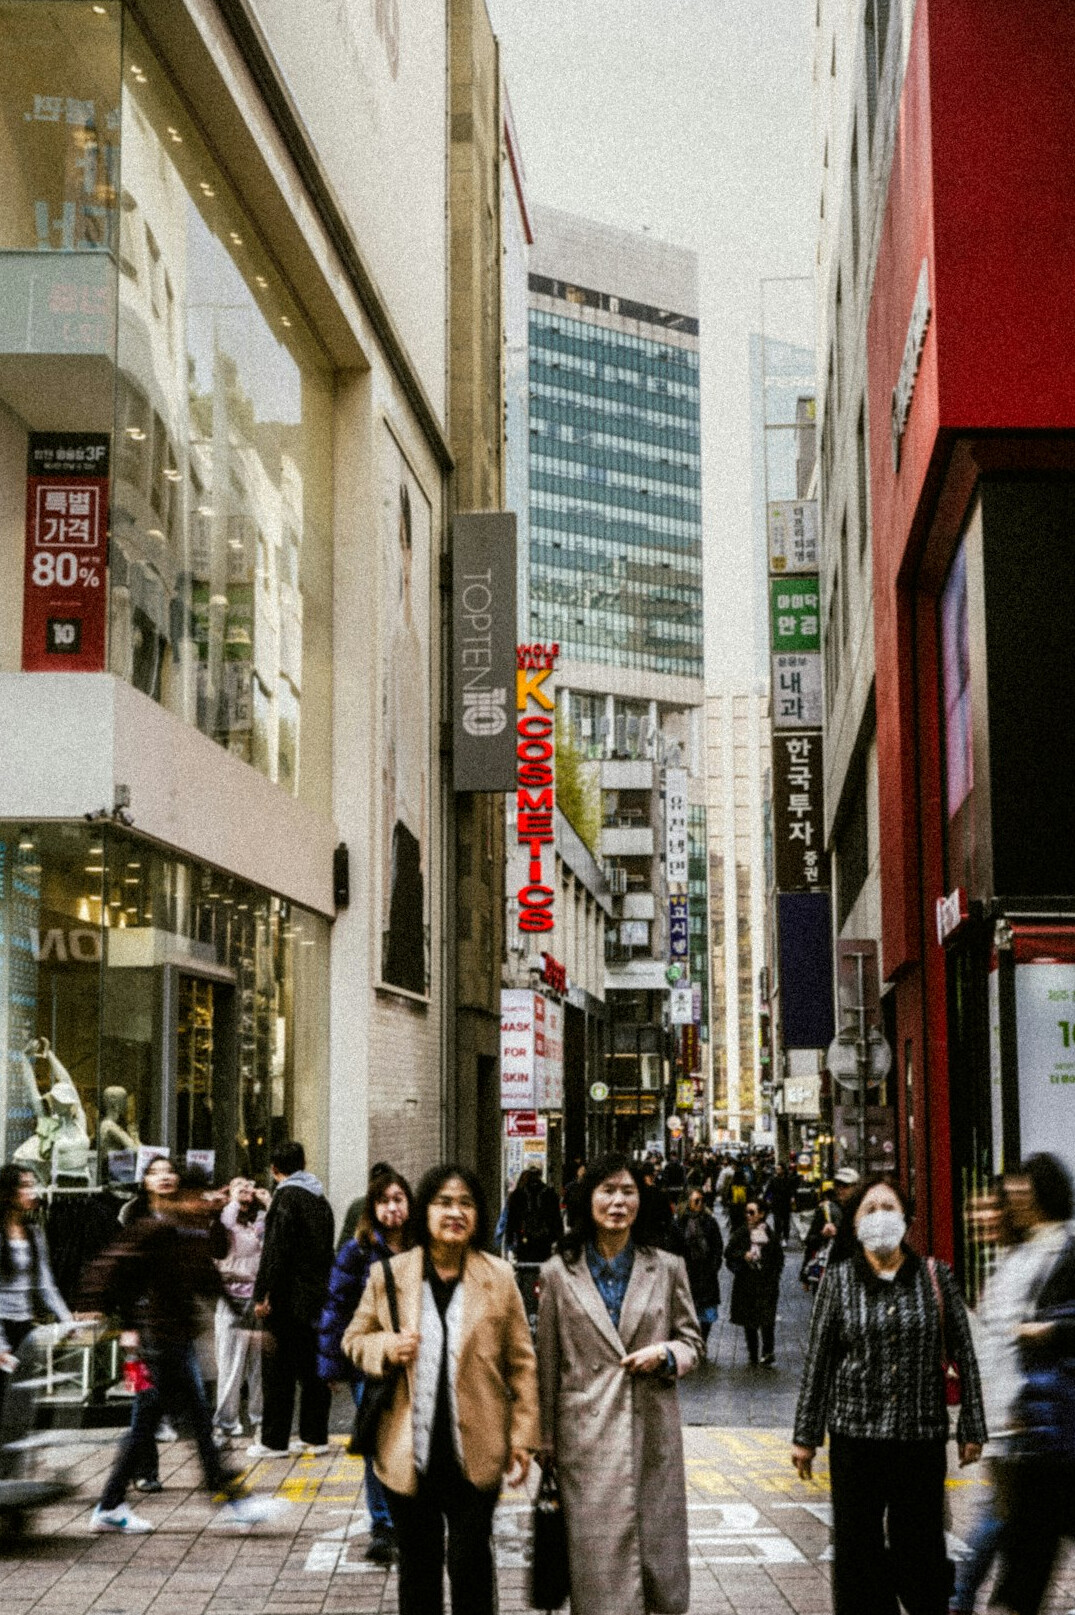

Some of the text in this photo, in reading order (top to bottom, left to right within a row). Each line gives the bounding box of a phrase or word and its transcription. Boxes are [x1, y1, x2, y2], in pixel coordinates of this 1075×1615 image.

[86, 446, 106, 461] 3F
[45, 492, 90, 515] 특별
[43, 518, 90, 542] 가격
[32, 552, 100, 588] 80%
[53, 623, 75, 645] 10
[780, 672, 804, 719] 내과
[516, 669, 555, 932] K COSMETICS
[786, 738, 814, 846] 한국투자
[504, 1047, 527, 1057] FOR
[502, 1072, 529, 1083] SKIN
